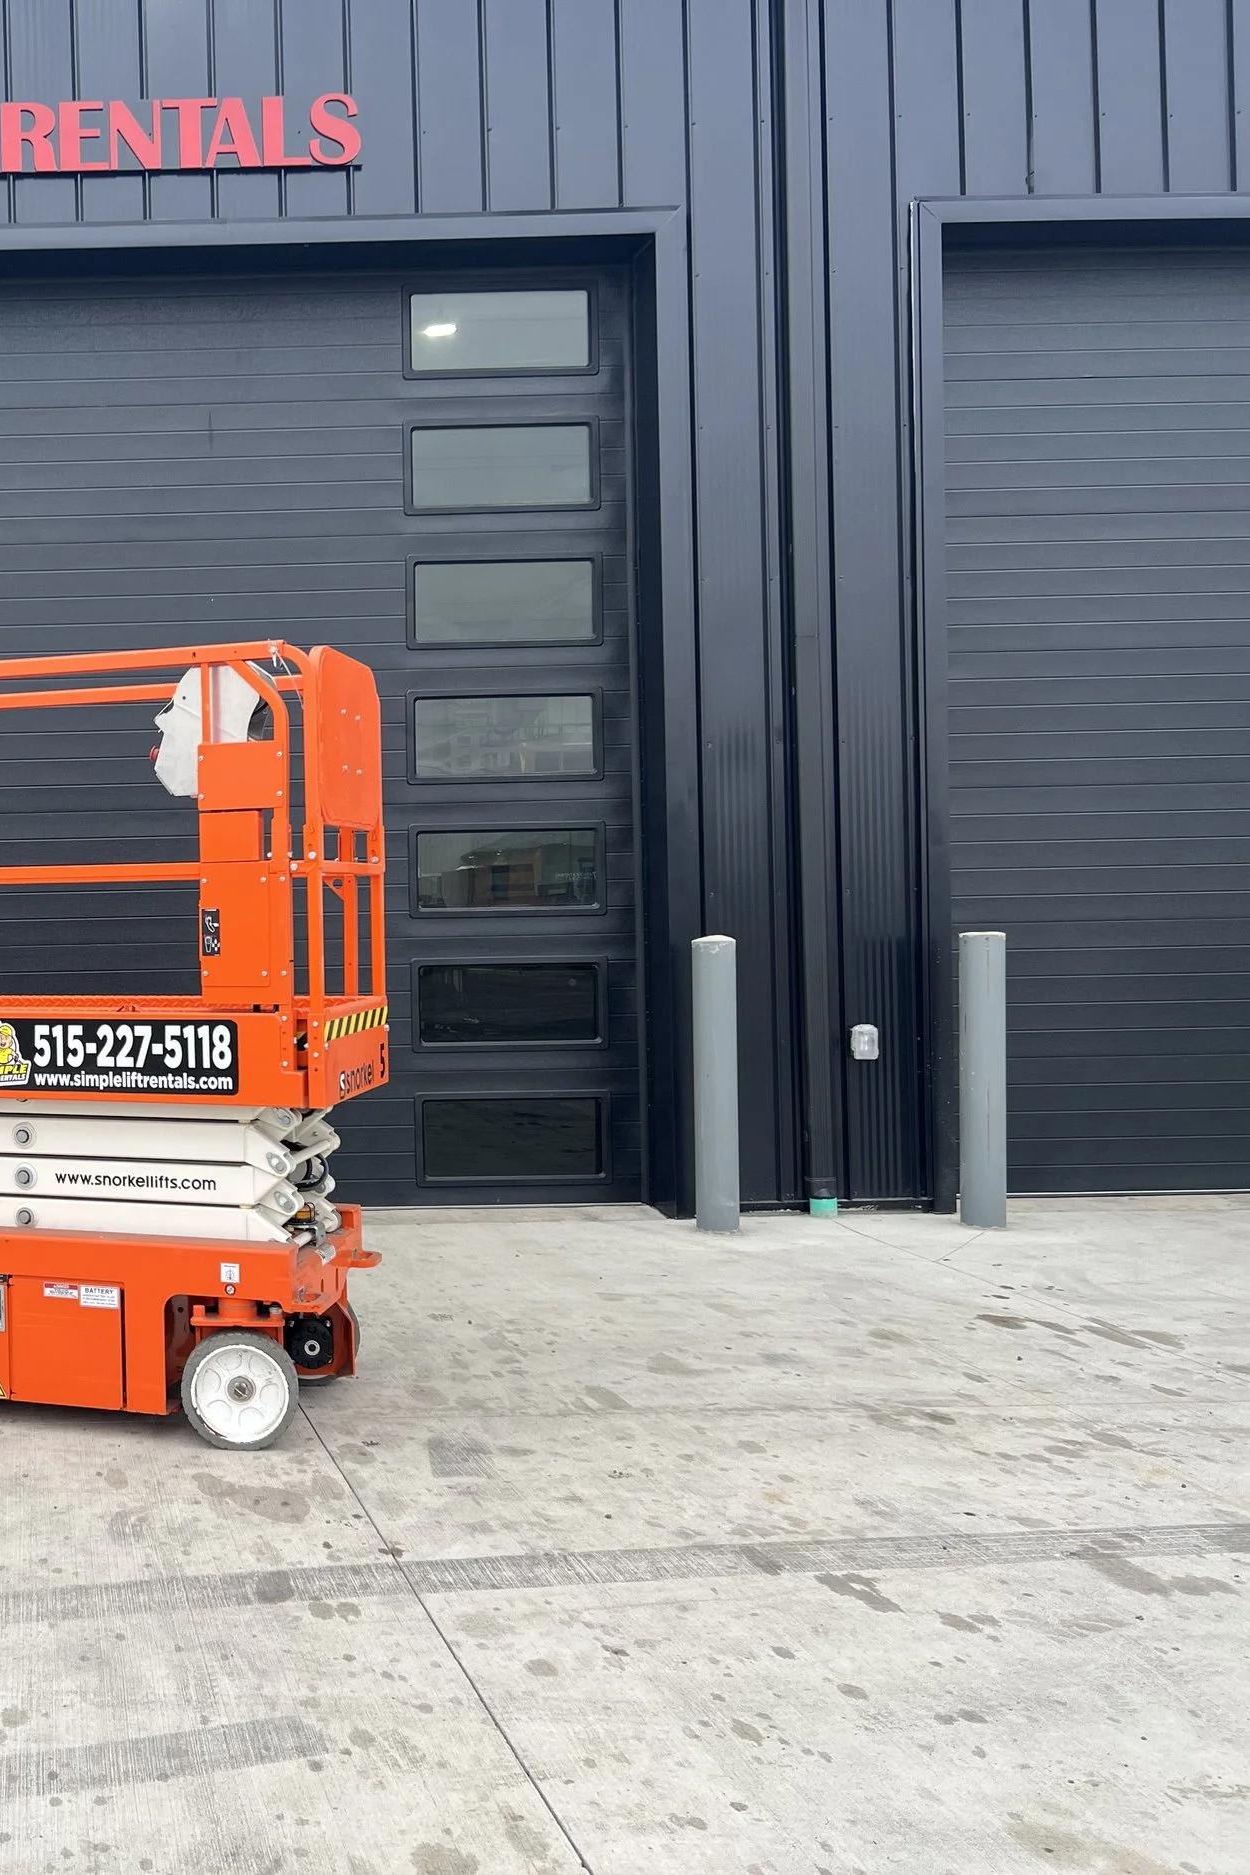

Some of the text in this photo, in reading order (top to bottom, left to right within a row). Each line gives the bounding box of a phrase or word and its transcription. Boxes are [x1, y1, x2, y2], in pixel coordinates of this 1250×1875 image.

[0, 92, 363, 173] RENTALS
[33, 1023, 233, 1070] 515-227-5118
[34, 1070, 233, 1090] www.simpleliftrentals.com
[55, 1172, 217, 1191] www.snorkellifts.com
[84, 1287, 114, 1295] BATTERY
